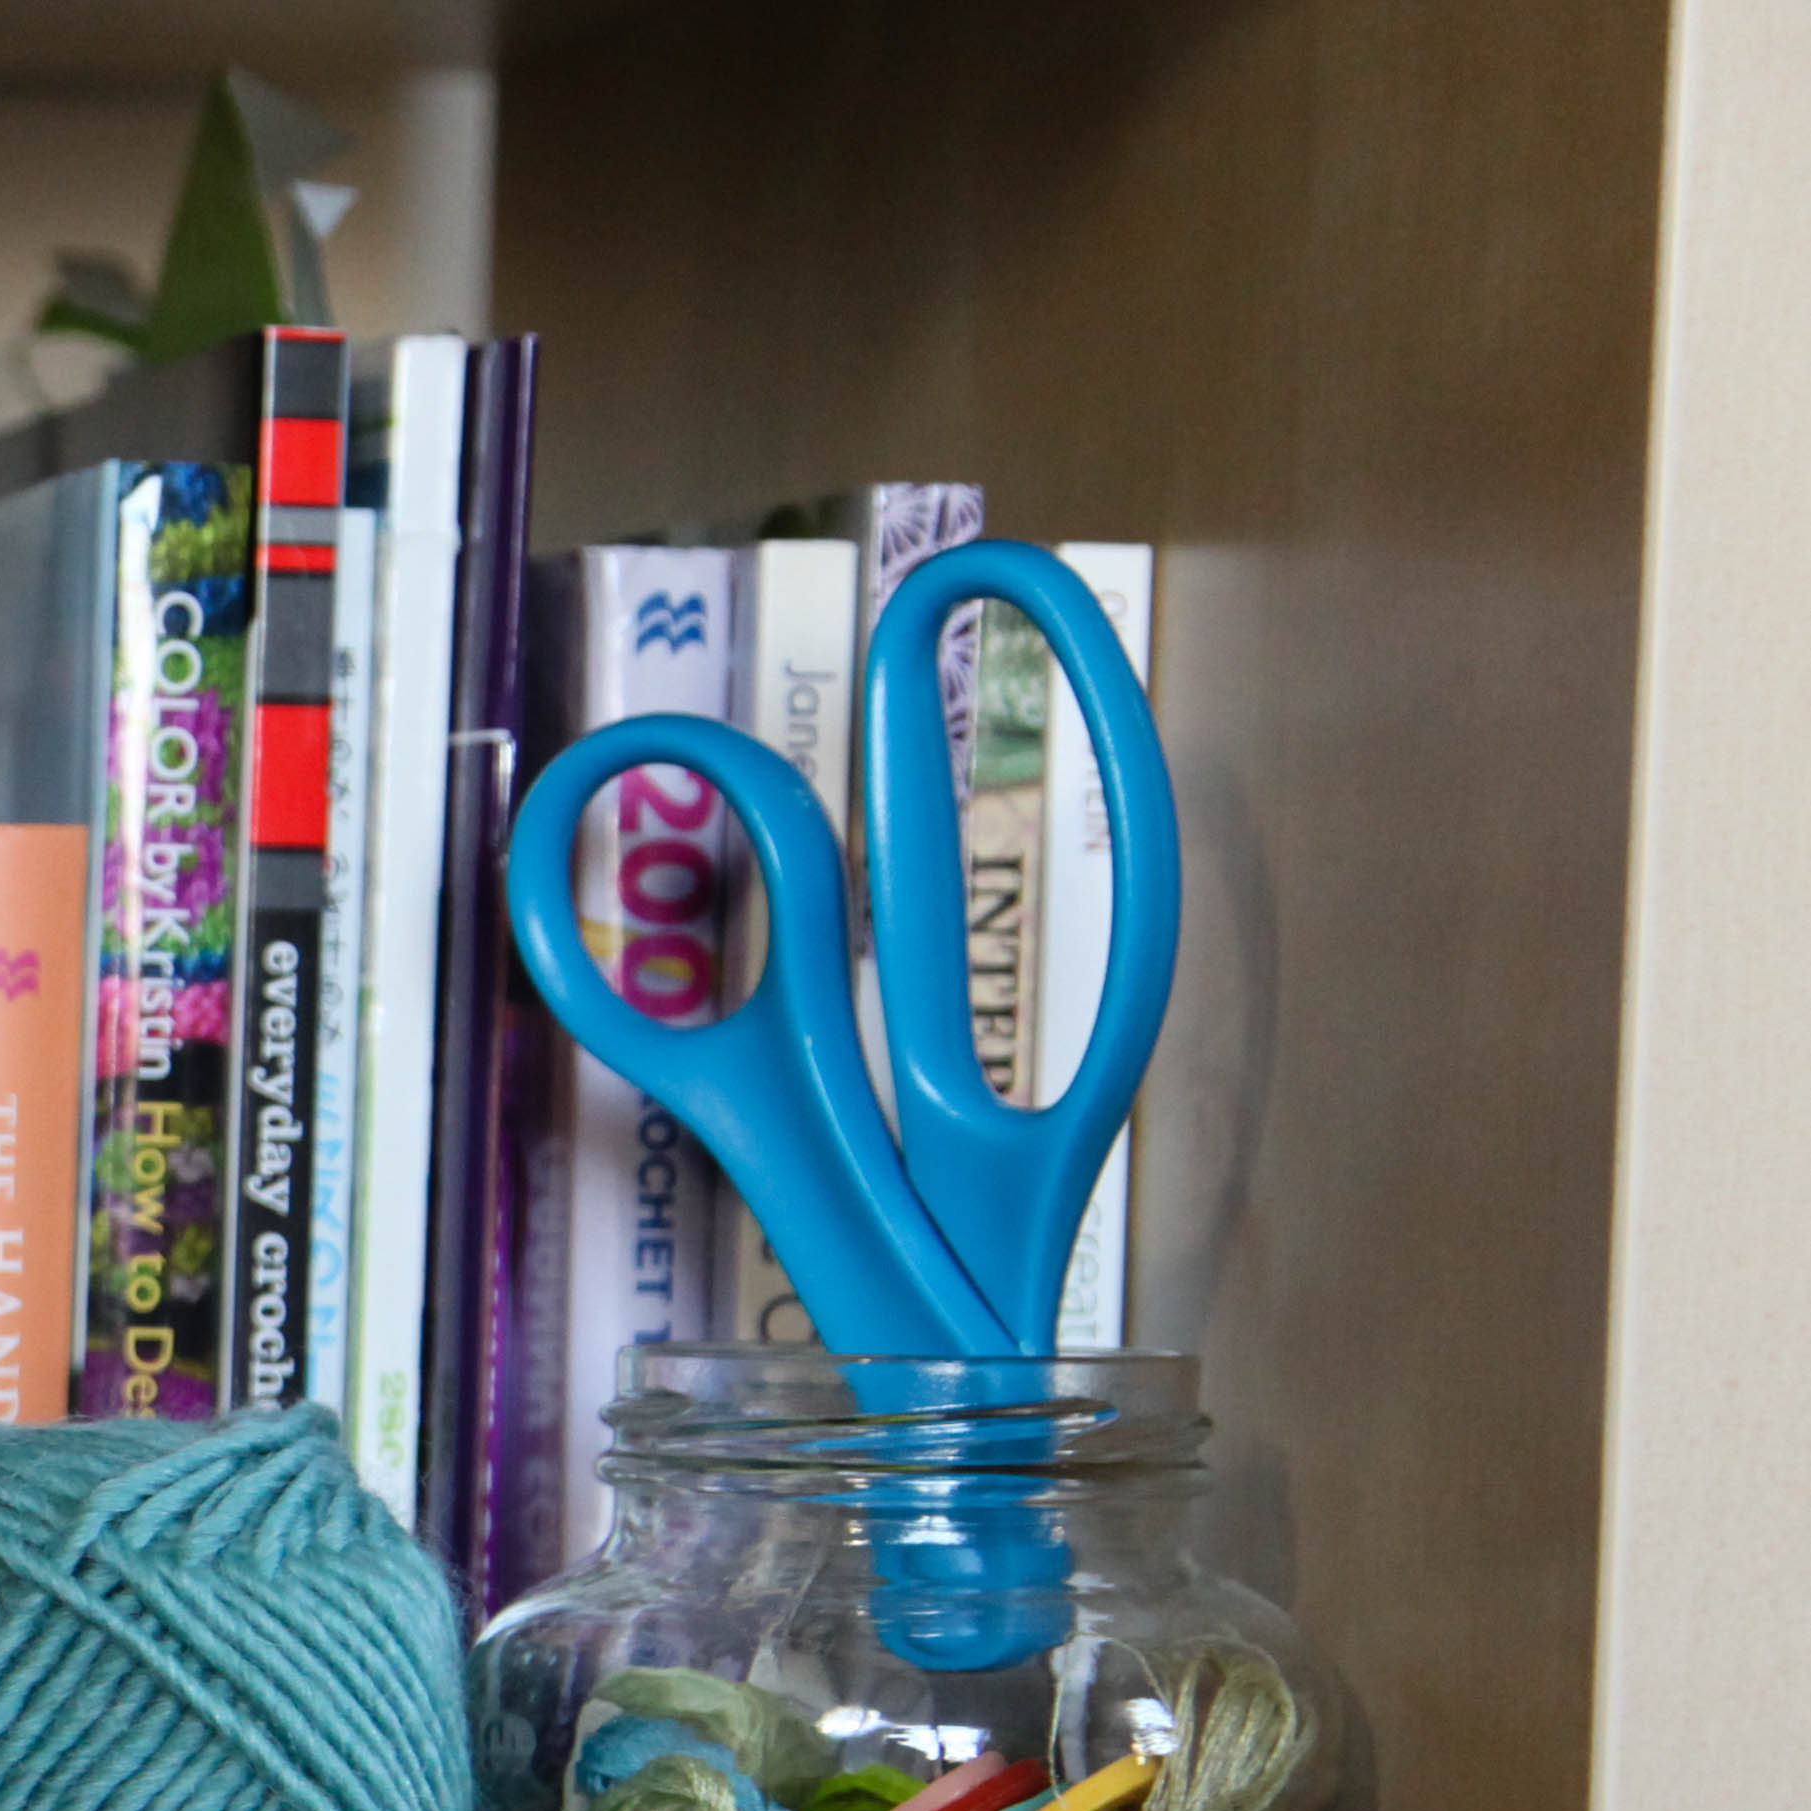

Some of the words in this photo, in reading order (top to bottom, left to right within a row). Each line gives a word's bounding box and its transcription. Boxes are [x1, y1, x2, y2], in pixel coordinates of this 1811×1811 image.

[146, 589, 206, 822] COLOR
[140, 841, 180, 904] by
[136, 906, 192, 1083] Kristin
[243, 939, 304, 1218] everyday
[130, 1101, 183, 1235] How
[123, 1252, 166, 1315] to
